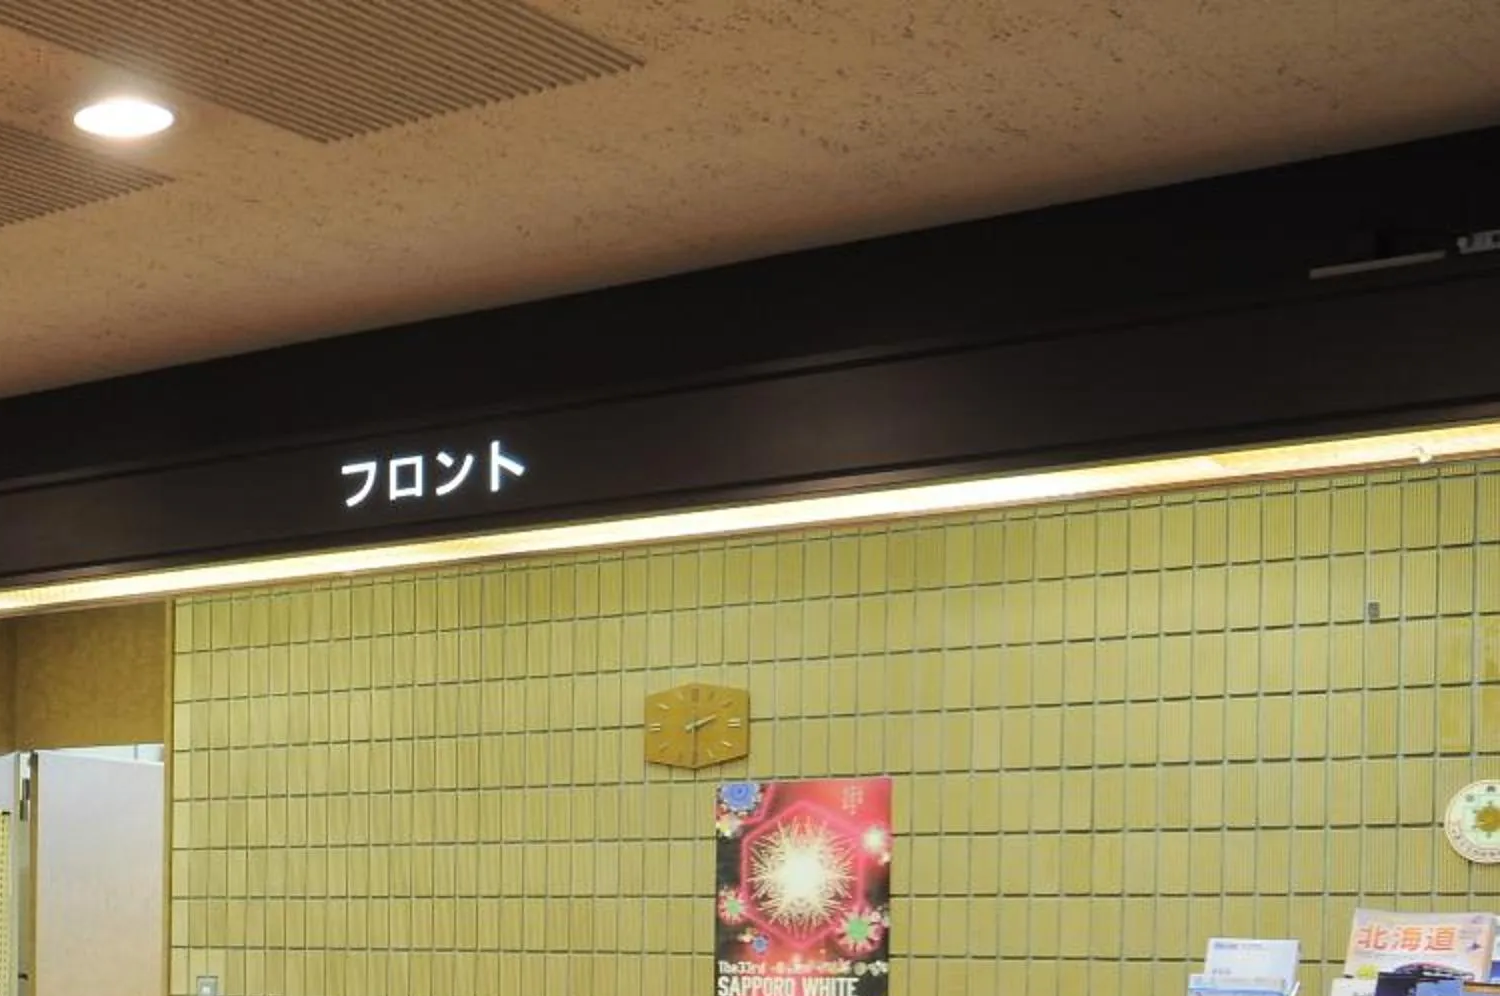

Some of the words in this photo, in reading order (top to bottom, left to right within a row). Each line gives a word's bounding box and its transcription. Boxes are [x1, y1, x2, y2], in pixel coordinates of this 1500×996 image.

[341, 440, 526, 508] フロント
[1357, 923, 1458, 952] 北海道
